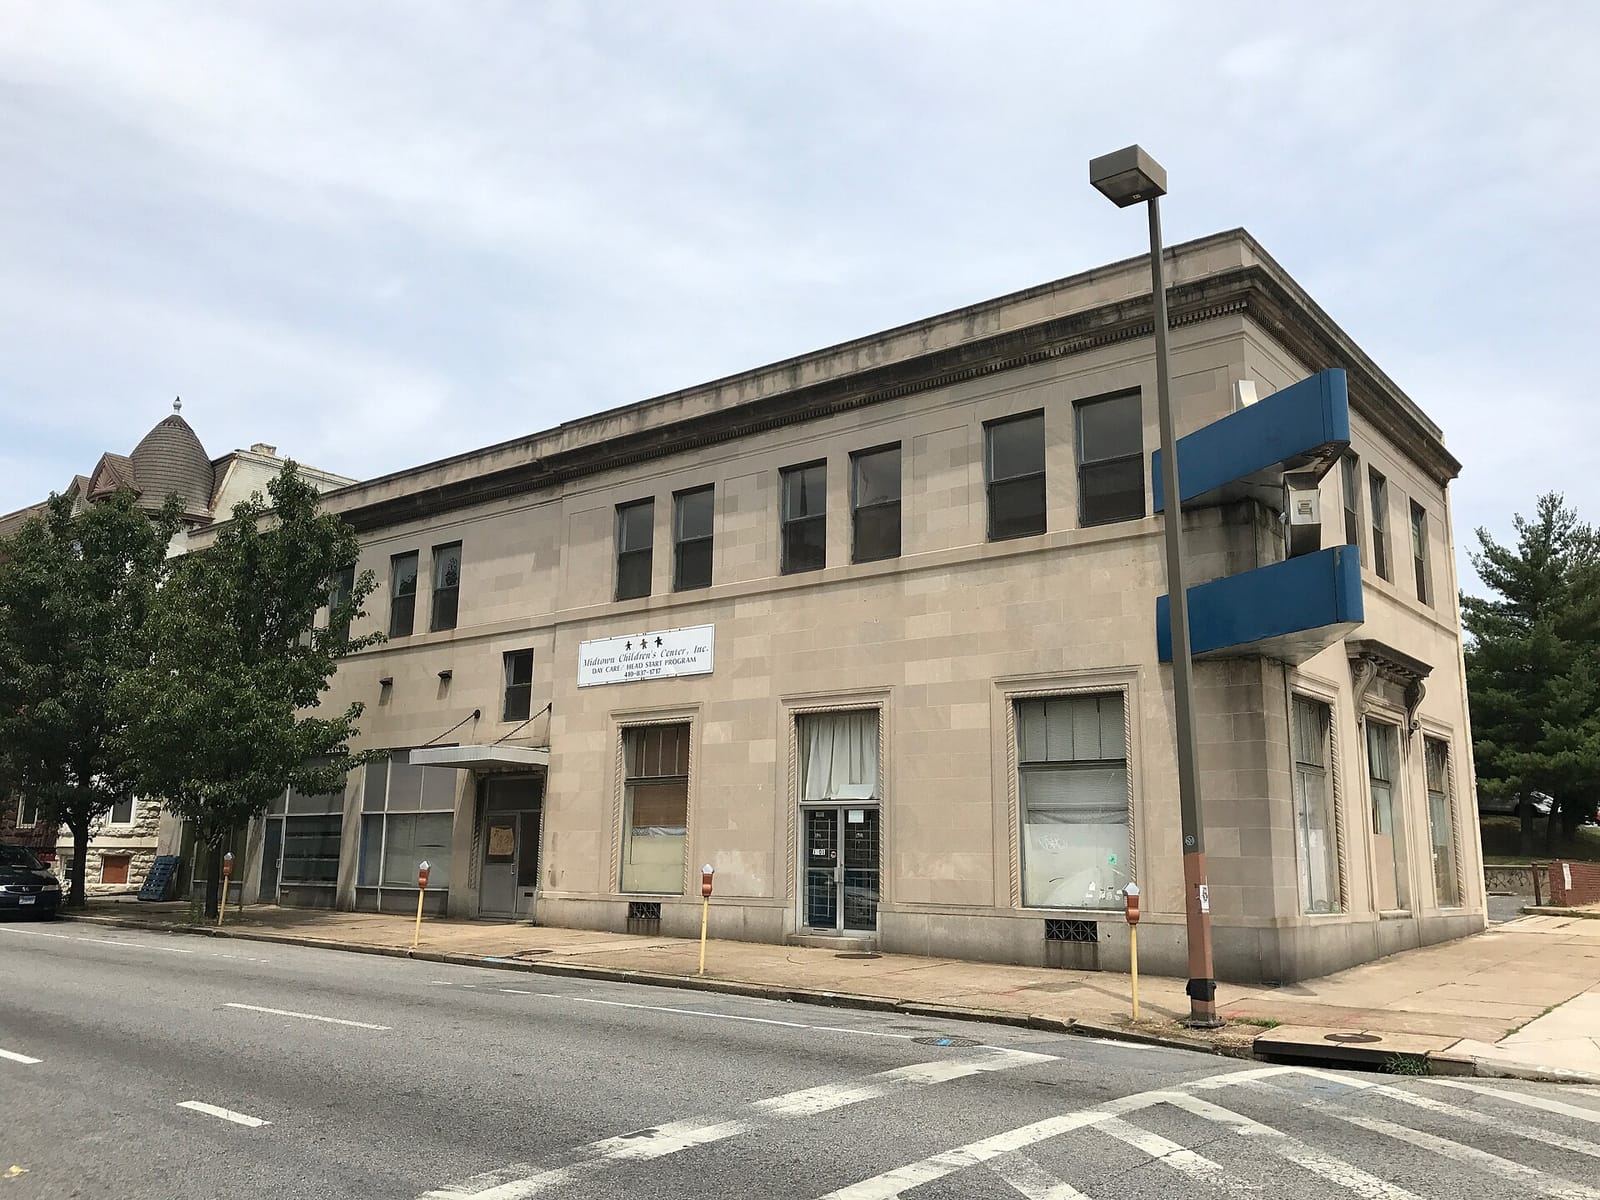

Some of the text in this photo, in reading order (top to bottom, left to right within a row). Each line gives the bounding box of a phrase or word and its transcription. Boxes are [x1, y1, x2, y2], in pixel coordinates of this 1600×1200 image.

[584, 645, 709, 667] Midtown Children's Center, Inc.
[626, 662, 644, 670] HEAD
[645, 660, 663, 669] START
[664, 656, 697, 666] PROGRAM
